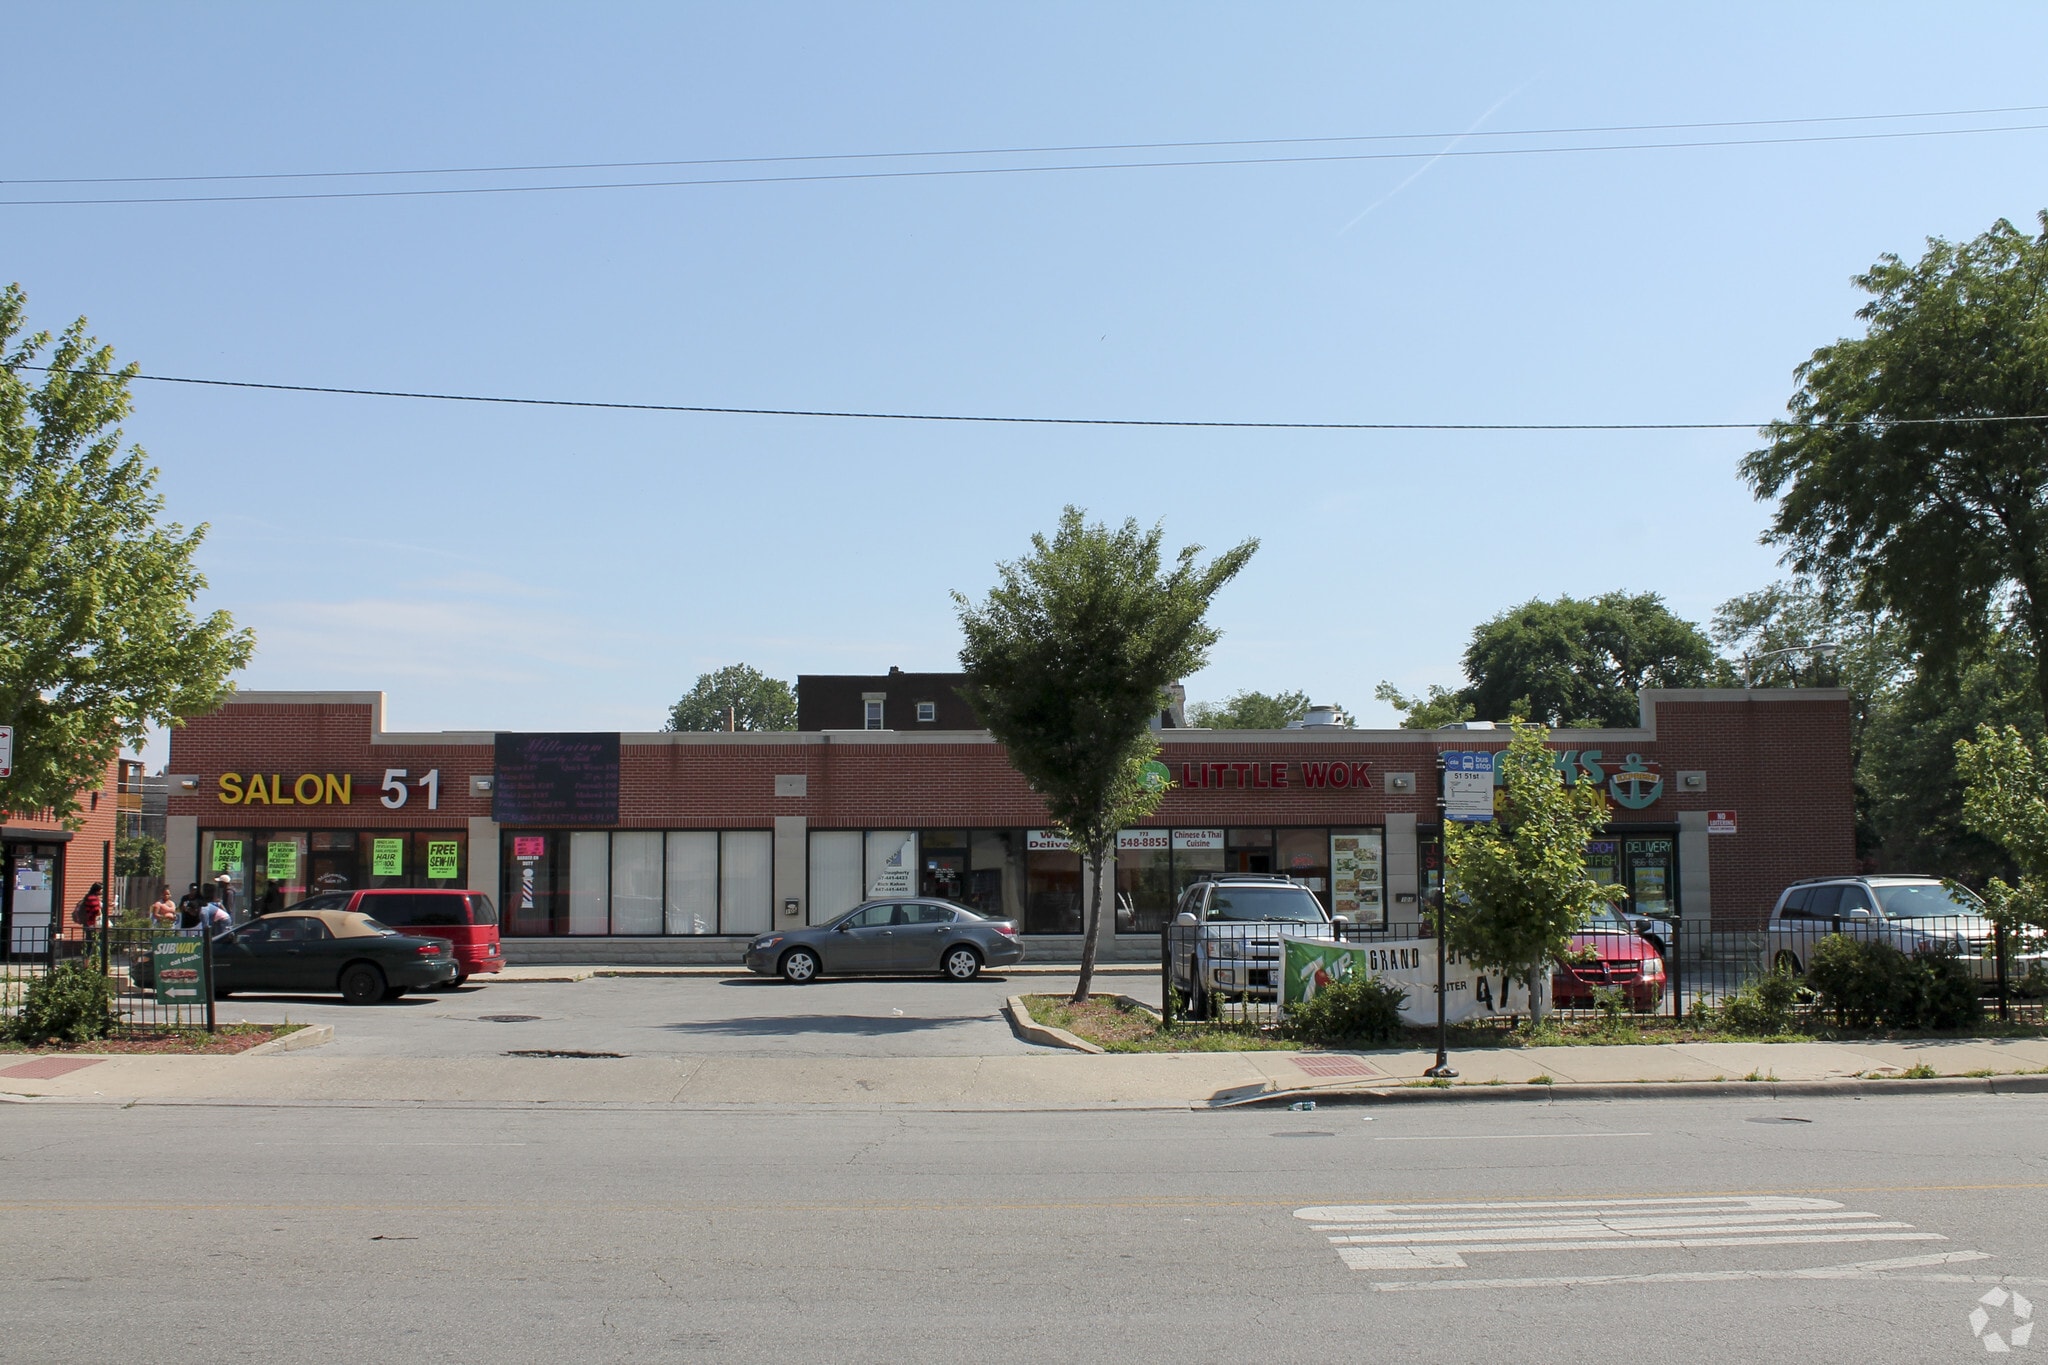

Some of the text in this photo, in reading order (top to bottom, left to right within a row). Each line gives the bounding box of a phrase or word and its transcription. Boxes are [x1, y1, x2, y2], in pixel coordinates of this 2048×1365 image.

[1475, 763, 1491, 771] stop
[1182, 761, 1373, 789] LITTLE WOK
[1616, 773, 1656, 782] EXPRESS
[218, 768, 439, 810] SALON 51
[1493, 790, 1504, 811] &
[215, 841, 240, 849] TWIST
[1120, 838, 1168, 847] 548-8855
[1584, 842, 1614, 853] ERCH
[1625, 841, 1671, 853] DELIVERY
[219, 848, 236, 856] LOCS
[430, 844, 456, 855] FREE
[429, 856, 456, 867] SEW-IN
[1584, 855, 1617, 866] ATFISH
[153, 942, 201, 955] SUBWAY
[169, 958, 181, 966] eat
[1370, 947, 1420, 970] GRAND
[1441, 980, 1467, 992] ITER
